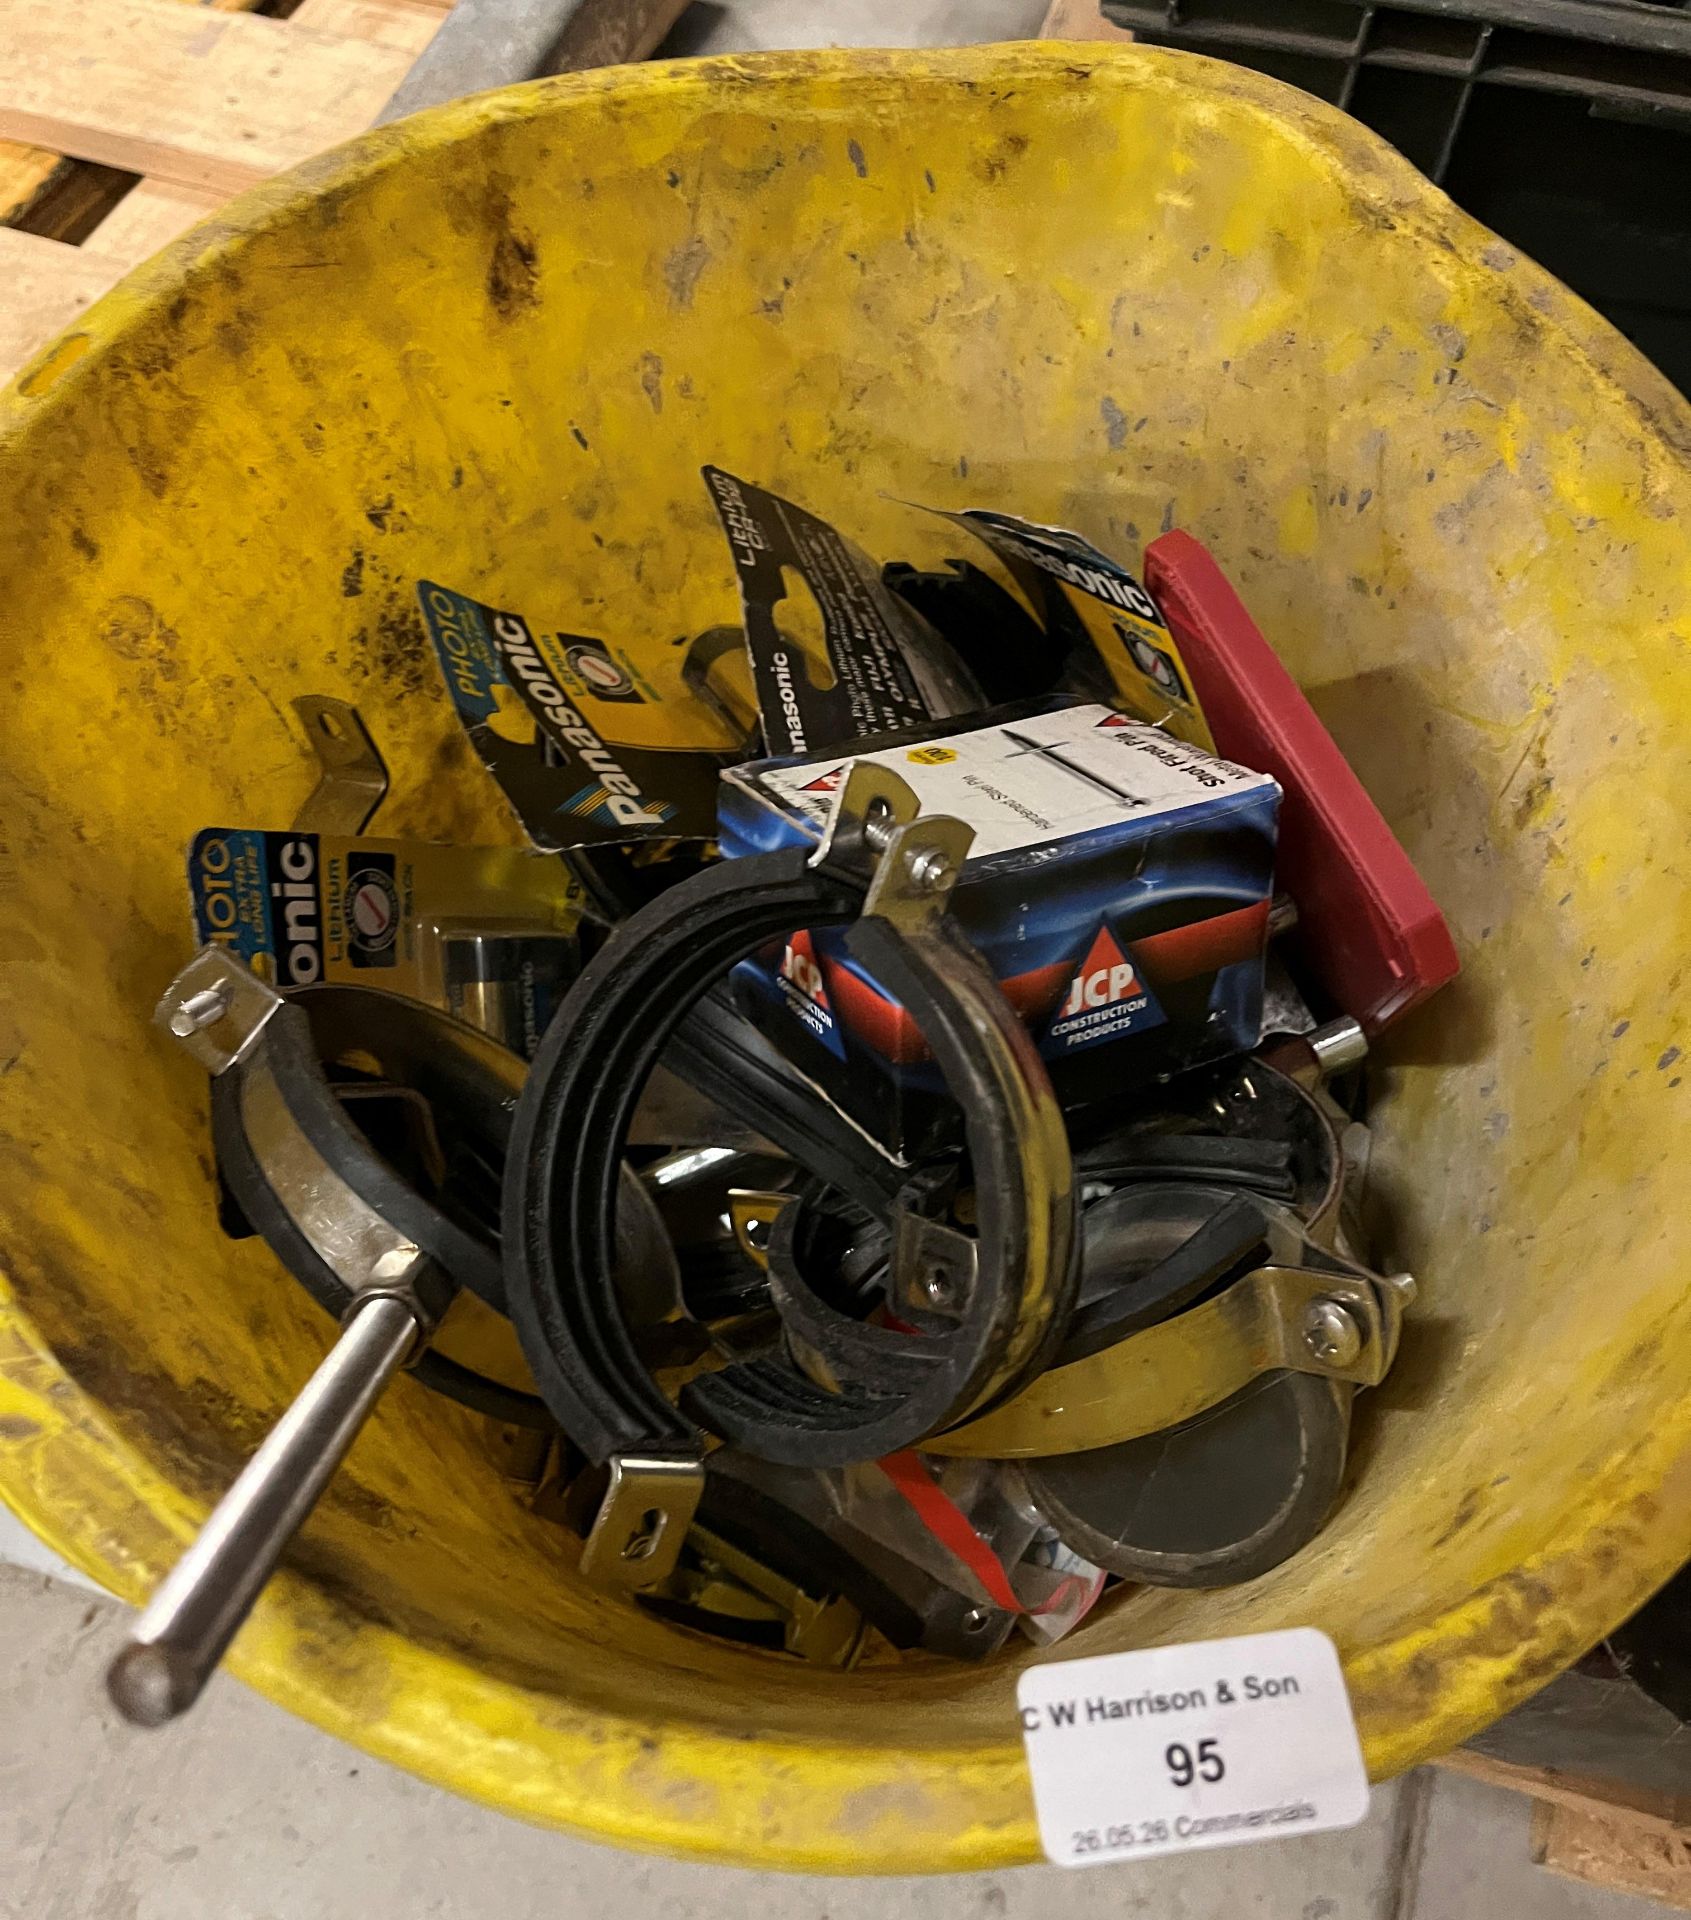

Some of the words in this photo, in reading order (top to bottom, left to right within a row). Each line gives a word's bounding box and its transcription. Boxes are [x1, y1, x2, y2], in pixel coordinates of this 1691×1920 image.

[711, 473, 757, 567] Lithium
[431, 589, 486, 698] PHOTO
[862, 655, 885, 691] FUJI
[493, 616, 665, 826] Panasonic
[1114, 732, 1147, 746] Pin
[1137, 744, 1187, 767] Fired
[1179, 765, 1225, 787] Shot
[962, 775, 984, 786] Pin
[201, 838, 240, 950] HOTO
[784, 945, 822, 1000] JCP
[1067, 963, 1134, 1016] JCP
[1051, 997, 1147, 1036] CONSTRUCTION
[1066, 1016, 1131, 1046] PRODUCTS
[1020, 1707, 1040, 1732] C
[1050, 1703, 1076, 1729] W
[1087, 1686, 1207, 1722] Harrison
[1216, 1679, 1235, 1704] &
[1243, 1674, 1300, 1700] Son
[1165, 1738, 1226, 1787] 95
